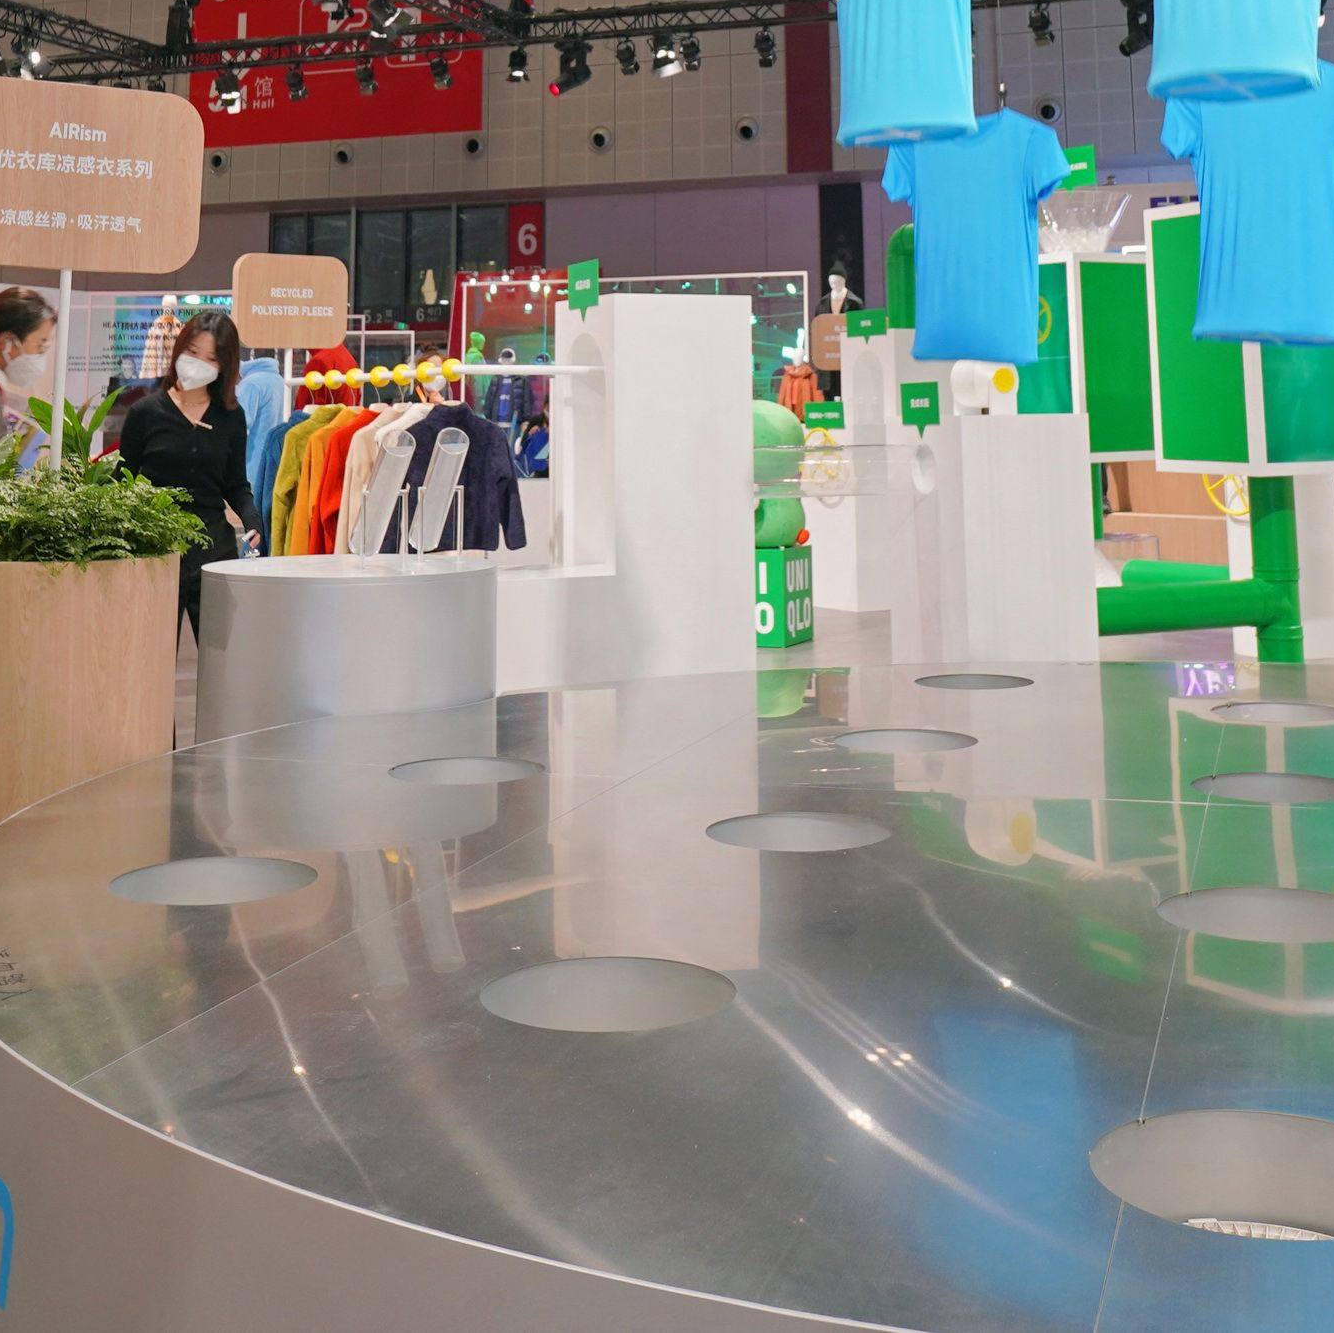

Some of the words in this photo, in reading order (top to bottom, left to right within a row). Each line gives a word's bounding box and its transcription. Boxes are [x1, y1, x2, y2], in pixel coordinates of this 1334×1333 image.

[254, 76, 273, 98] 馆
[252, 98, 275, 110] Hall
[49, 121, 107, 142] AIRism
[0, 208, 142, 233] 凉感丝滑·吸汗透气
[517, 223, 539, 257] 6
[270, 287, 314, 299] RECYCLED
[252, 304, 299, 316] POLYESTER
[301, 305, 334, 318] FLEECE
[786, 558, 809, 593] UNI
[788, 597, 811, 638] QLO
